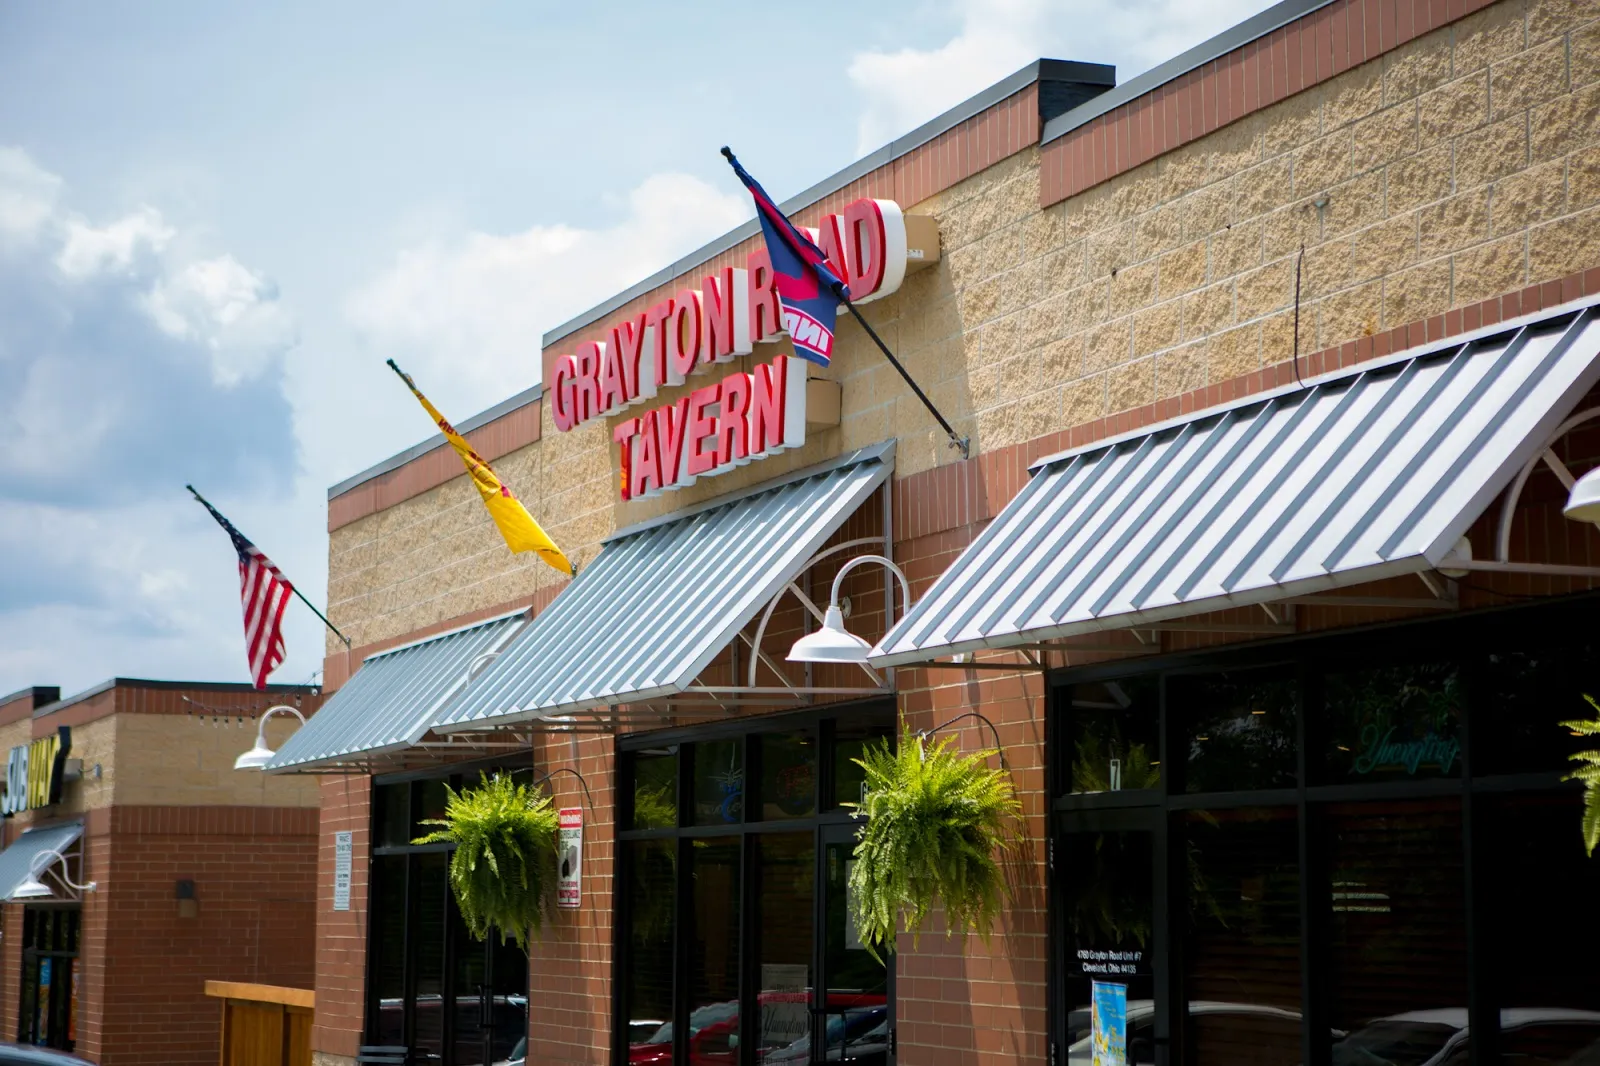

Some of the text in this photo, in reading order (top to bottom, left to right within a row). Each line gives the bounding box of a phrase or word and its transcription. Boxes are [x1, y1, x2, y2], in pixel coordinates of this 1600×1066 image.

[551, 197, 892, 432] GRAYTON RAD
[614, 355, 788, 500] TAVERN
[1108, 950, 1122, 960] Road
[1123, 951, 1133, 961] Unit
[1108, 963, 1120, 973] Ohio
